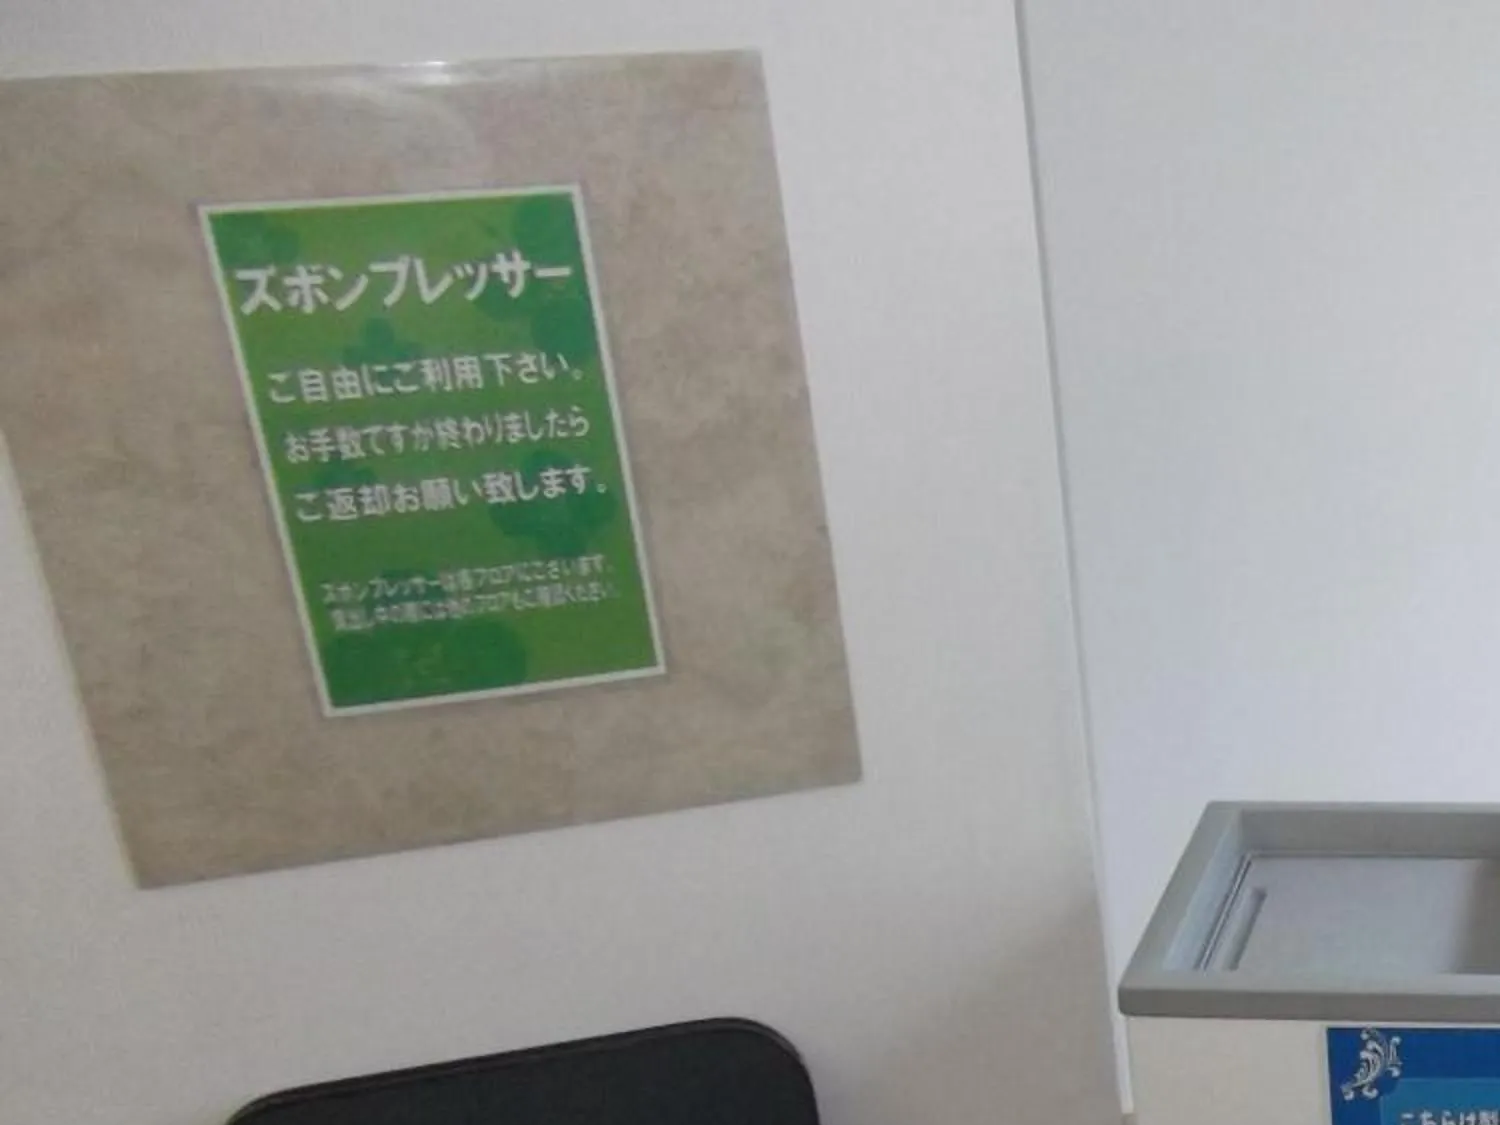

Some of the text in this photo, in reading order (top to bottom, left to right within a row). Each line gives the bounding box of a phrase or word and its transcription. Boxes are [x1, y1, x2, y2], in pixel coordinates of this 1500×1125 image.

[235, 250, 572, 315] ズボンプレッサー
[267, 352, 584, 403] ご自由にご利用下さい。
[285, 406, 590, 463] お手数ですが終わりましたら
[294, 465, 607, 522] ご返却お願い致します。
